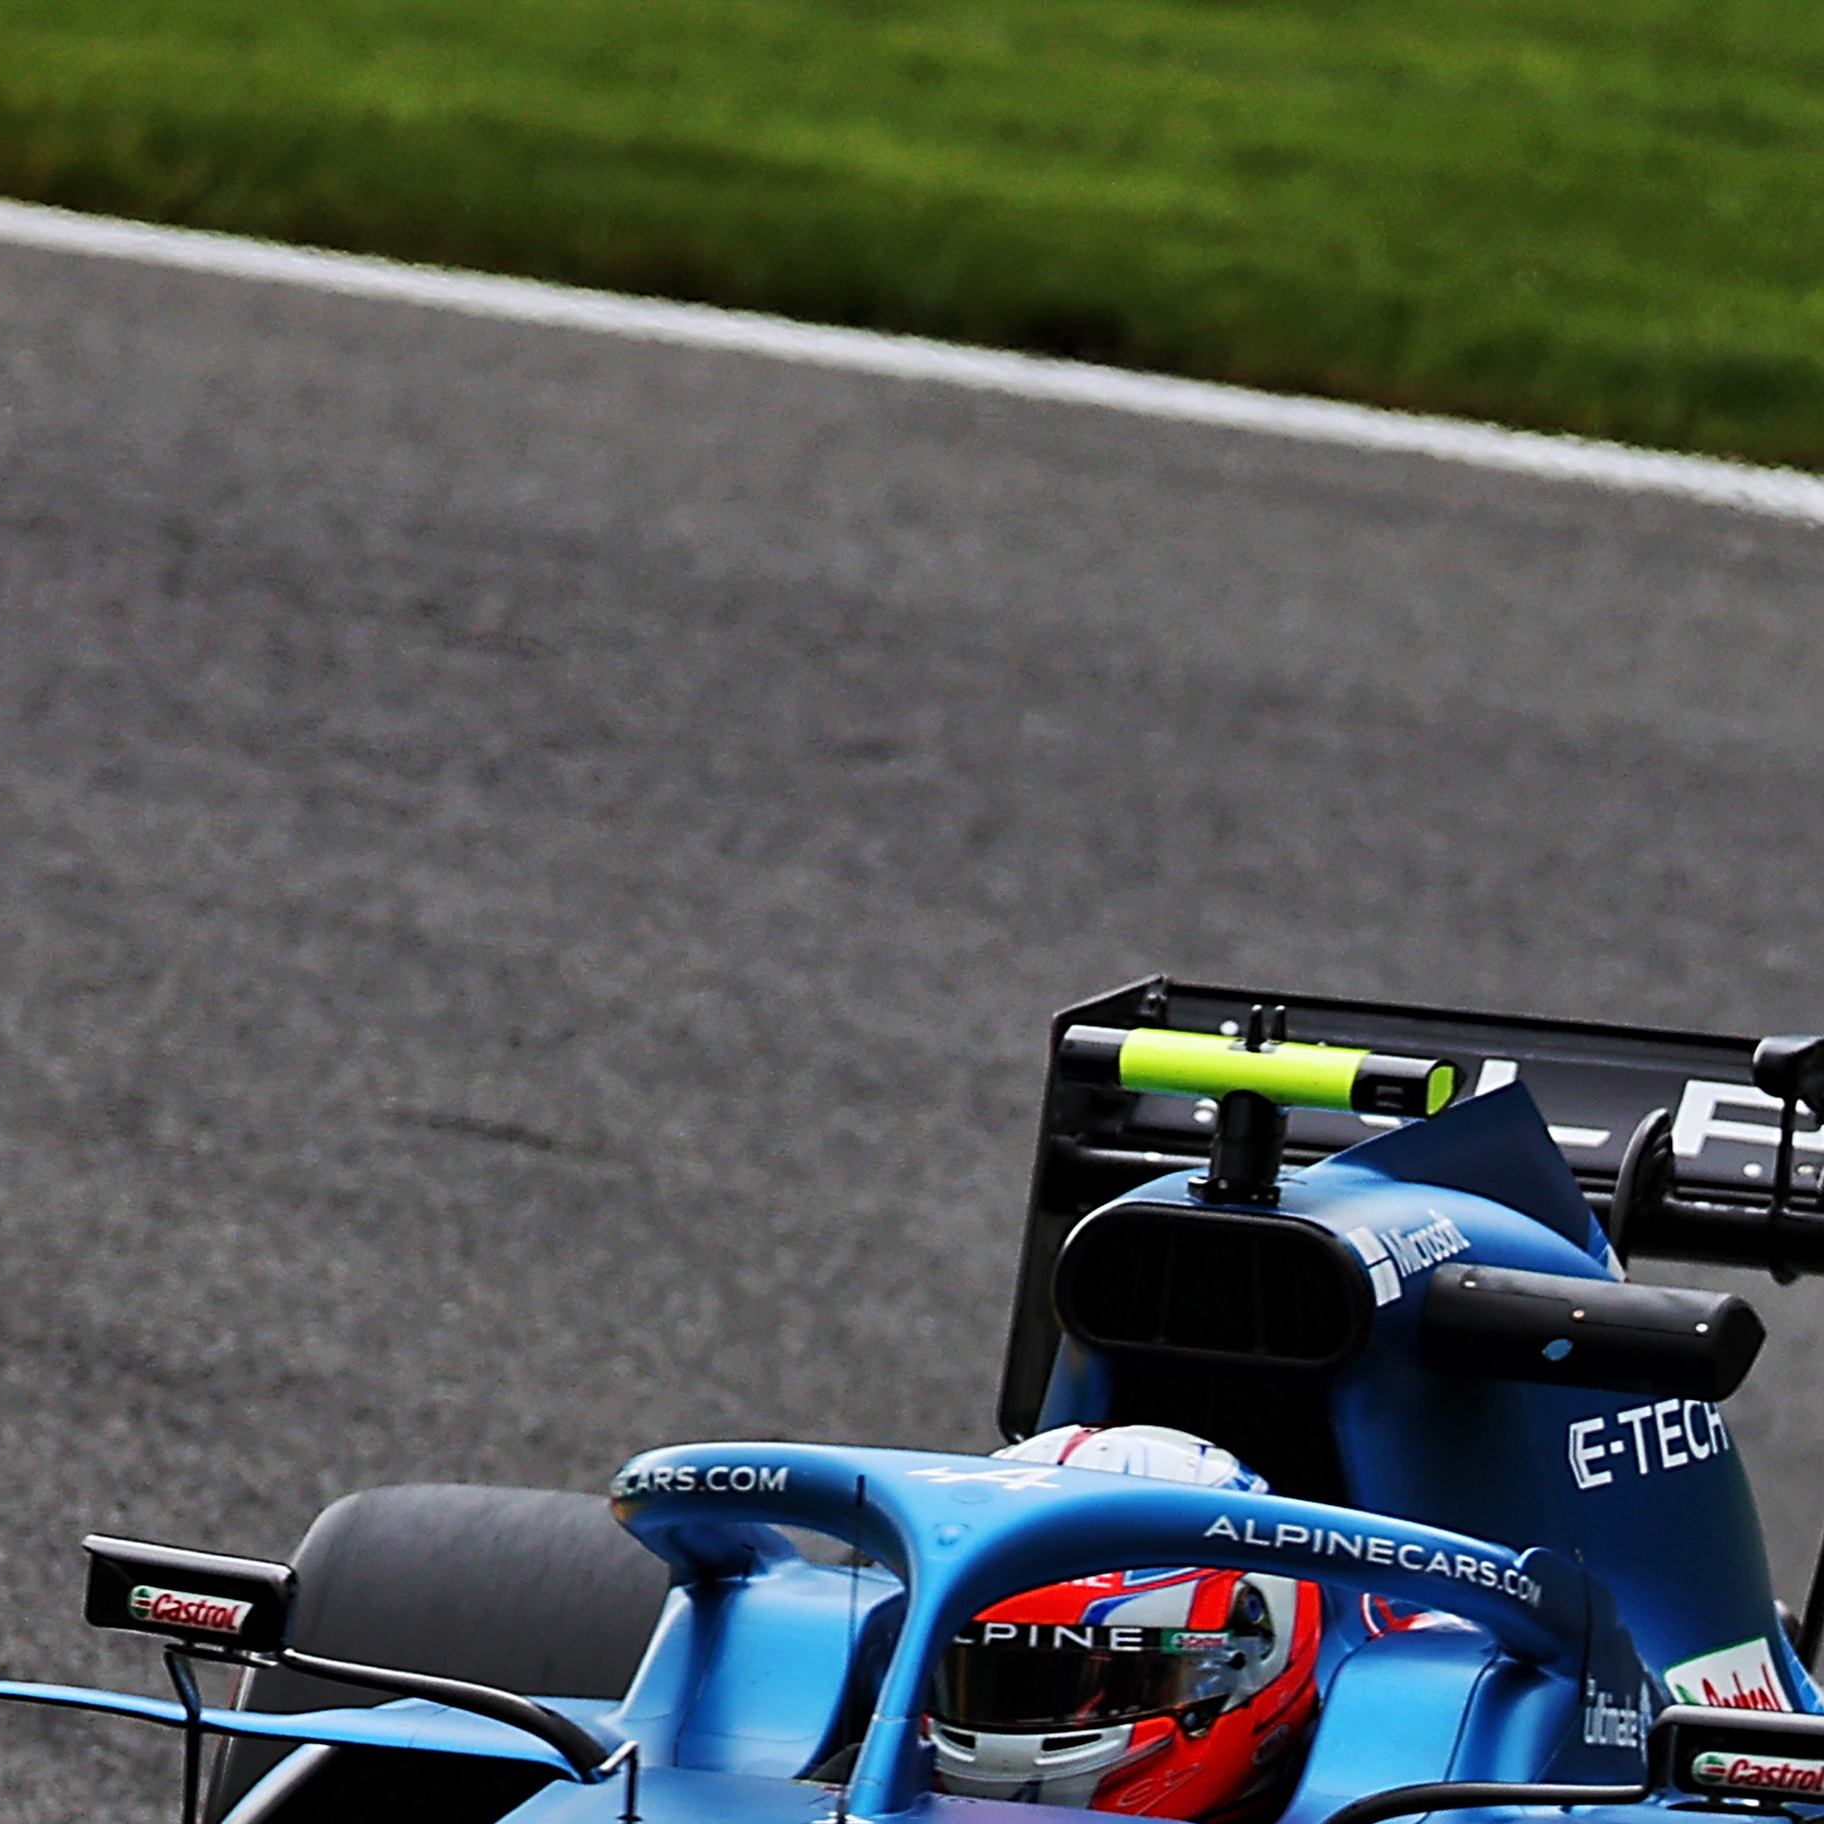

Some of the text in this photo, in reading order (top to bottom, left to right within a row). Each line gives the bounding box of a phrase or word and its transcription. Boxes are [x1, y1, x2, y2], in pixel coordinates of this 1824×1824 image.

[1379, 1209, 1471, 1277] Microsoft
[1568, 1398, 1729, 1490] E-TECH
[151, 1592, 242, 1632] Castrol
